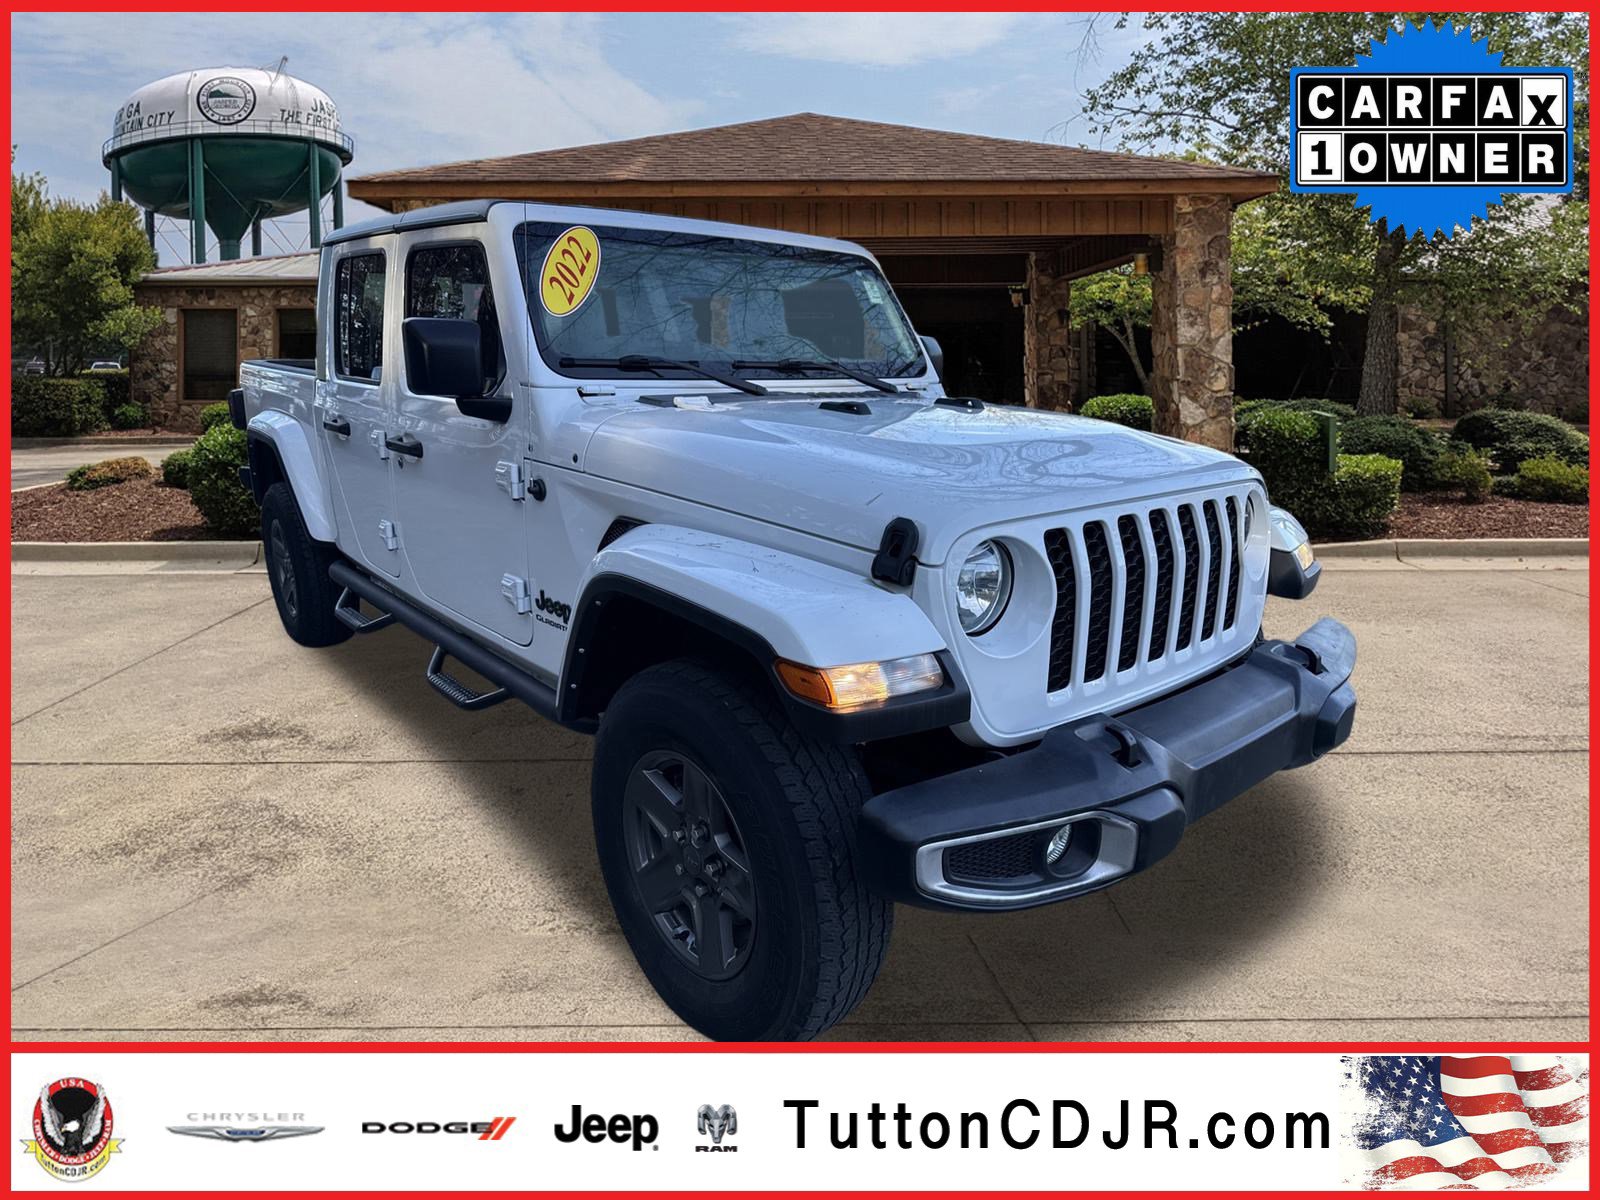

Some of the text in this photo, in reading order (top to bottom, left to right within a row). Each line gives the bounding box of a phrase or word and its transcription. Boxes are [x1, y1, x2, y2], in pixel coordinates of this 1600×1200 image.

[126, 101, 141, 119] GA
[147, 111, 176, 127] CITY
[280, 109, 302, 124] THE
[306, 113, 332, 129] FIRST
[549, 235, 592, 306] 2022
[535, 589, 572, 625] Jeep
